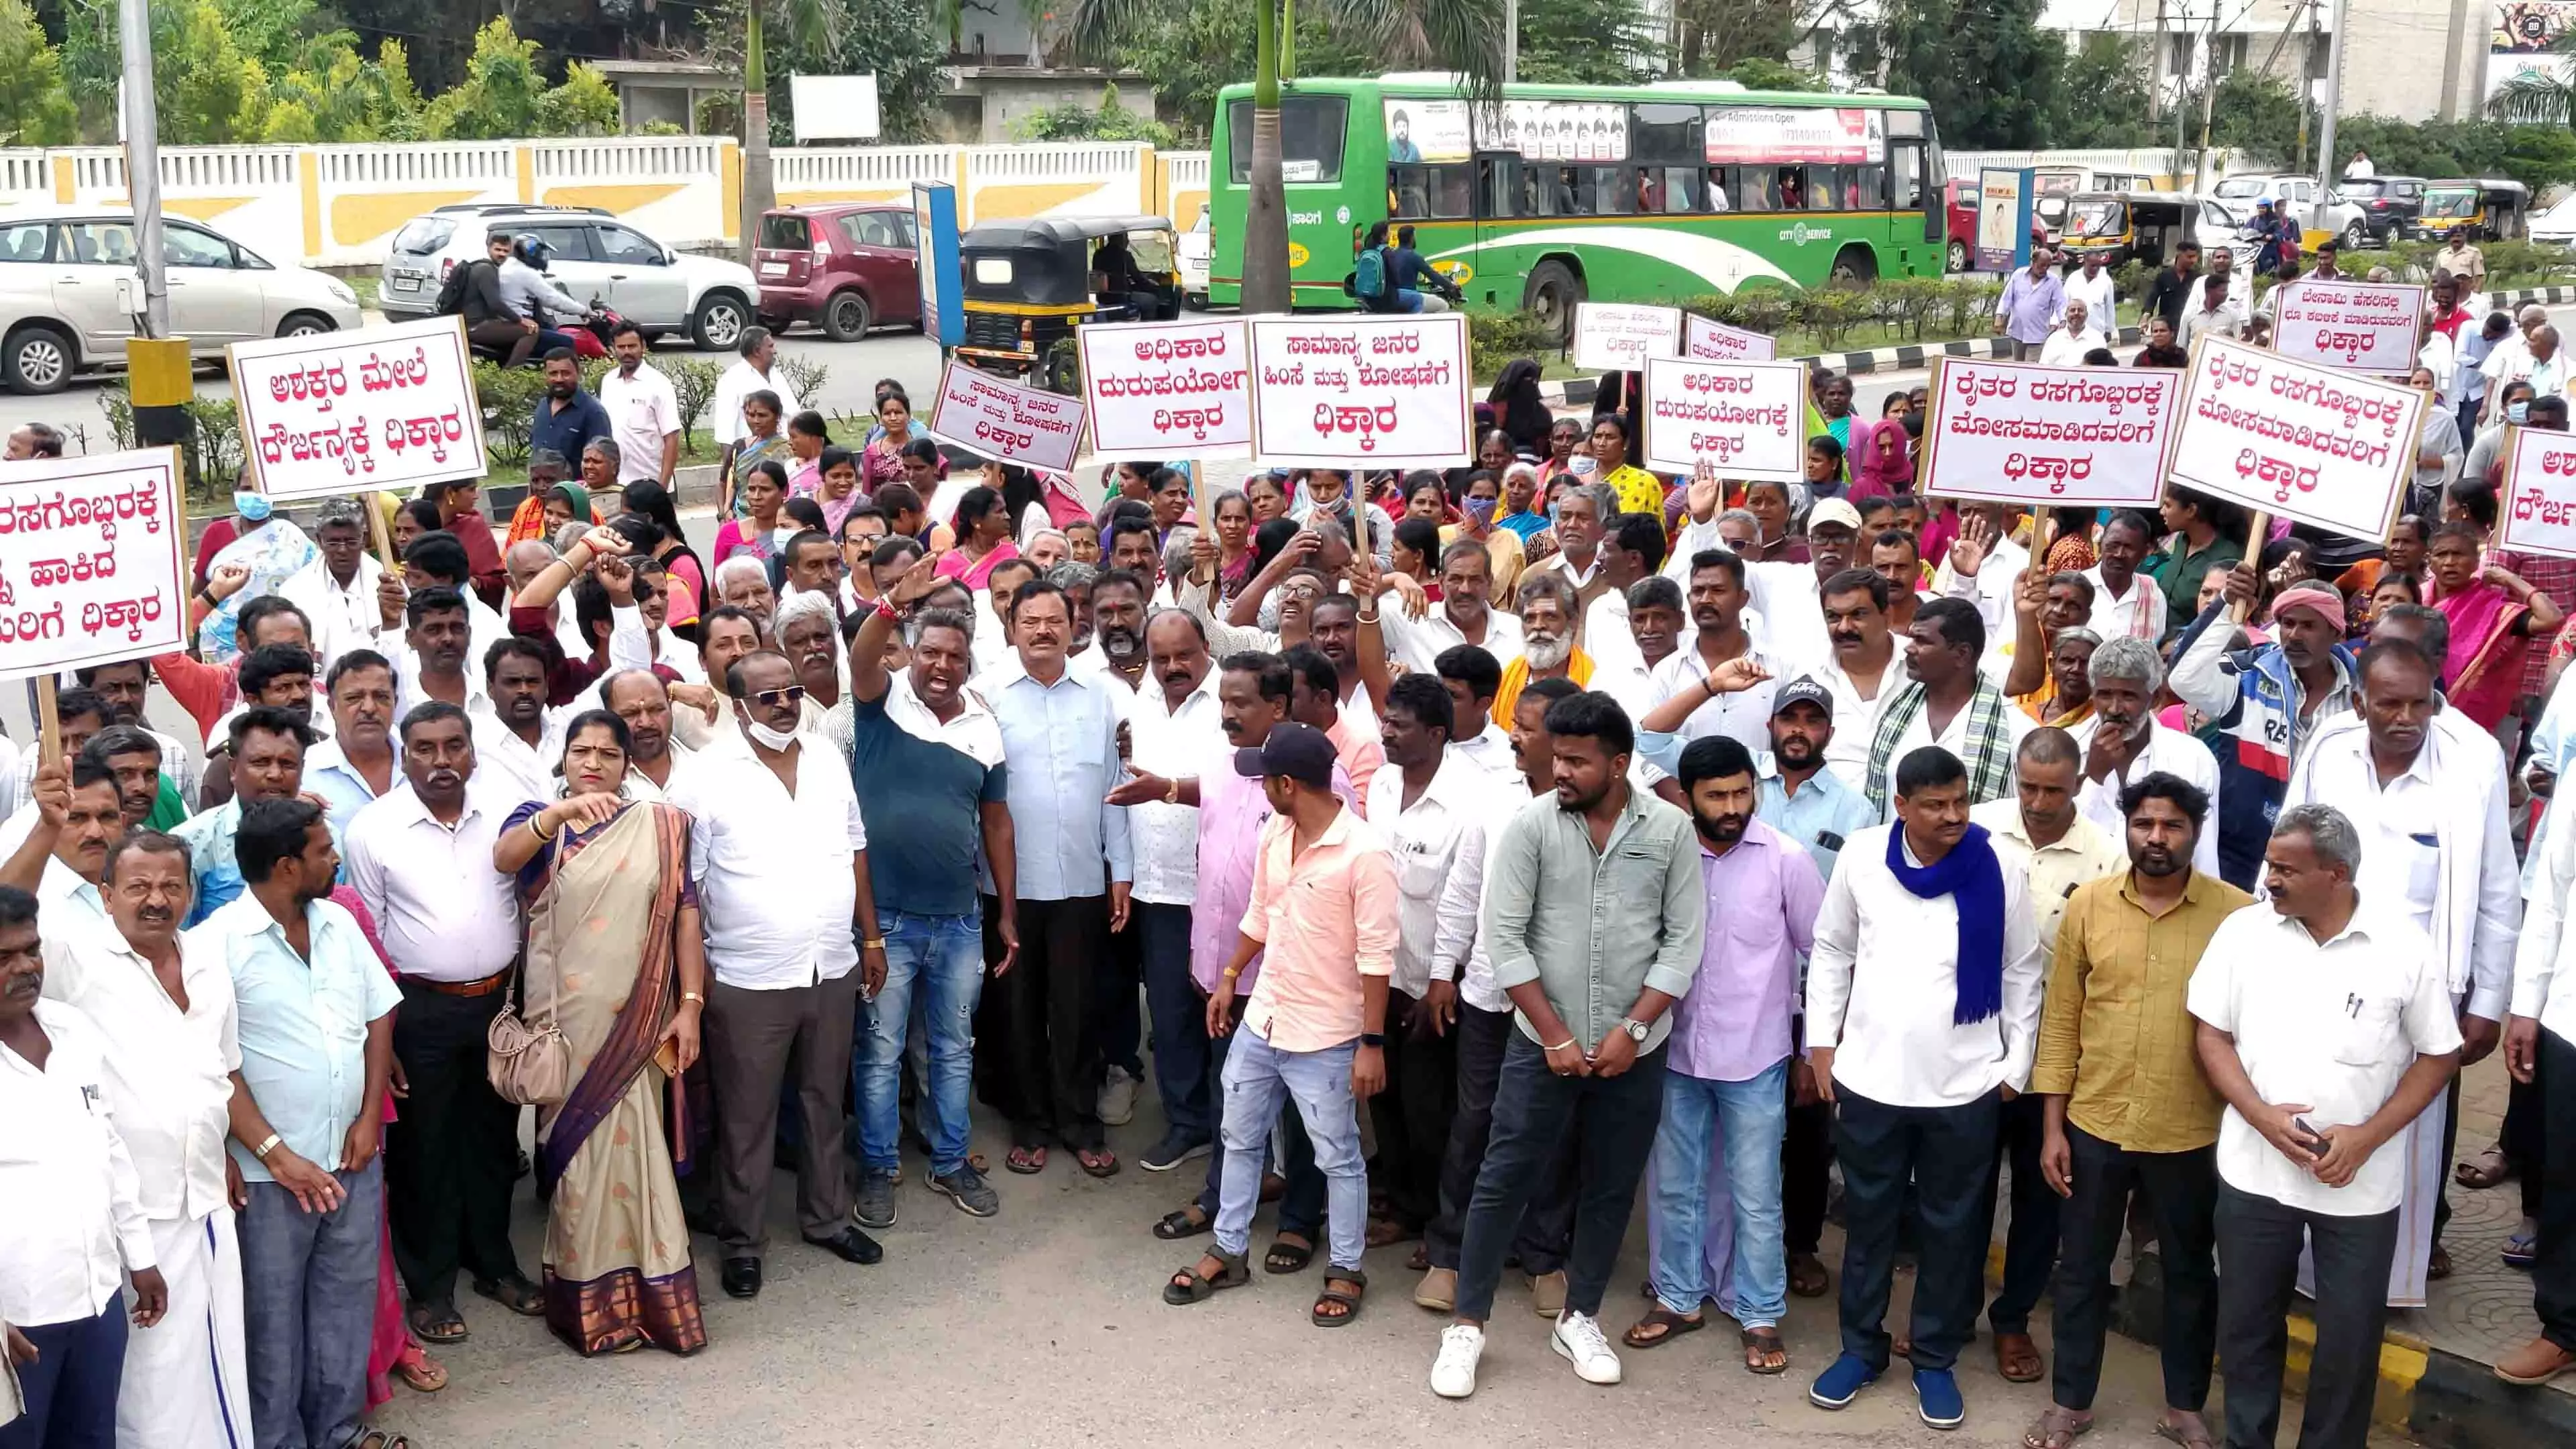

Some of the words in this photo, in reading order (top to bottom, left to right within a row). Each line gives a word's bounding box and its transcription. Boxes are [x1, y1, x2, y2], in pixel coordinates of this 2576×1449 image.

[1728, 112, 1774, 123] Admissions
[1775, 113, 1795, 125] Open
[1779, 230, 1793, 240] CITY
[1807, 229, 1832, 239] SERVICE
[1134, 329, 1226, 364] ಅಧಿಕಾರ
[1287, 330, 1362, 366] ಸಾಮಾನ್ಯ
[1372, 330, 1420, 354] ಜನರ
[1607, 337, 1647, 360] ಧಿಕ್ಕಾರ
[1709, 331, 1747, 350] ಅಧಿಕಾರ
[2315, 328, 2375, 363] ಧಿಕ್ಕಾರ
[270, 356, 347, 413] ಅಶಕ್ತರ
[360, 346, 428, 392] ಮೇಲೆ
[1097, 367, 1248, 397] ದುರುಪಯೋಗ
[1264, 362, 1303, 386] ಹಿಂಸೆ
[1313, 366, 1348, 393] ಮತ್ತು
[1358, 360, 1450, 389] ಶೋಷಣೆಗೆ
[1683, 372, 1754, 394] ಅಧಿಕಾರ
[1956, 370, 2017, 407] ರೈತರ
[2031, 377, 2163, 416] ರಸಗೊಬ್ಬರಕ್ಕೆ
[948, 389, 978, 407] ಹಿಂಸೆ
[983, 404, 1007, 422] ಮತ್ತು
[1013, 411, 1073, 435] ಶೋಷಣೆಗೆ
[969, 380, 1022, 411] ಸಾಮಾನ್ಯ
[1027, 398, 1060, 414] ಜನರ
[2208, 352, 2261, 390] ರೈತರ
[2270, 371, 2403, 438] ರಸಗೊಬ್ಬರಕ್ಕೆ
[1153, 401, 1224, 440] ಧಿಕ್ಕಾರ
[1313, 396, 1397, 451] ಧಿಕ್ಕಾರ
[1655, 397, 1788, 436] ದುರುಪಯೋಗಕ್ಕೆ
[1951, 411, 2156, 443] ಮೋಸಮಾಡಿದವರಿಗೆ
[2198, 394, 2390, 468] ಮೋಸಮಾಡಿದವರಿಗೆ
[260, 415, 375, 476] ದೌರ್ಜನ್ಯಕ್ಕೆ
[386, 403, 462, 463] ಧಿಕ್ಕಾರ
[975, 420, 1034, 455] ಧಿಕ್ಕಾರ
[1690, 431, 1744, 462] ಧಿಕ್ಕಾರ
[2004, 451, 2093, 494] ಧಿಕ್ಕಾರ
[2235, 447, 2321, 503] ಧಿಕ್ಕಾರ
[30, 542, 116, 587] ಹಾಕಿದ
[82, 585, 162, 642] ಧಿಕ್ಕಾರ
